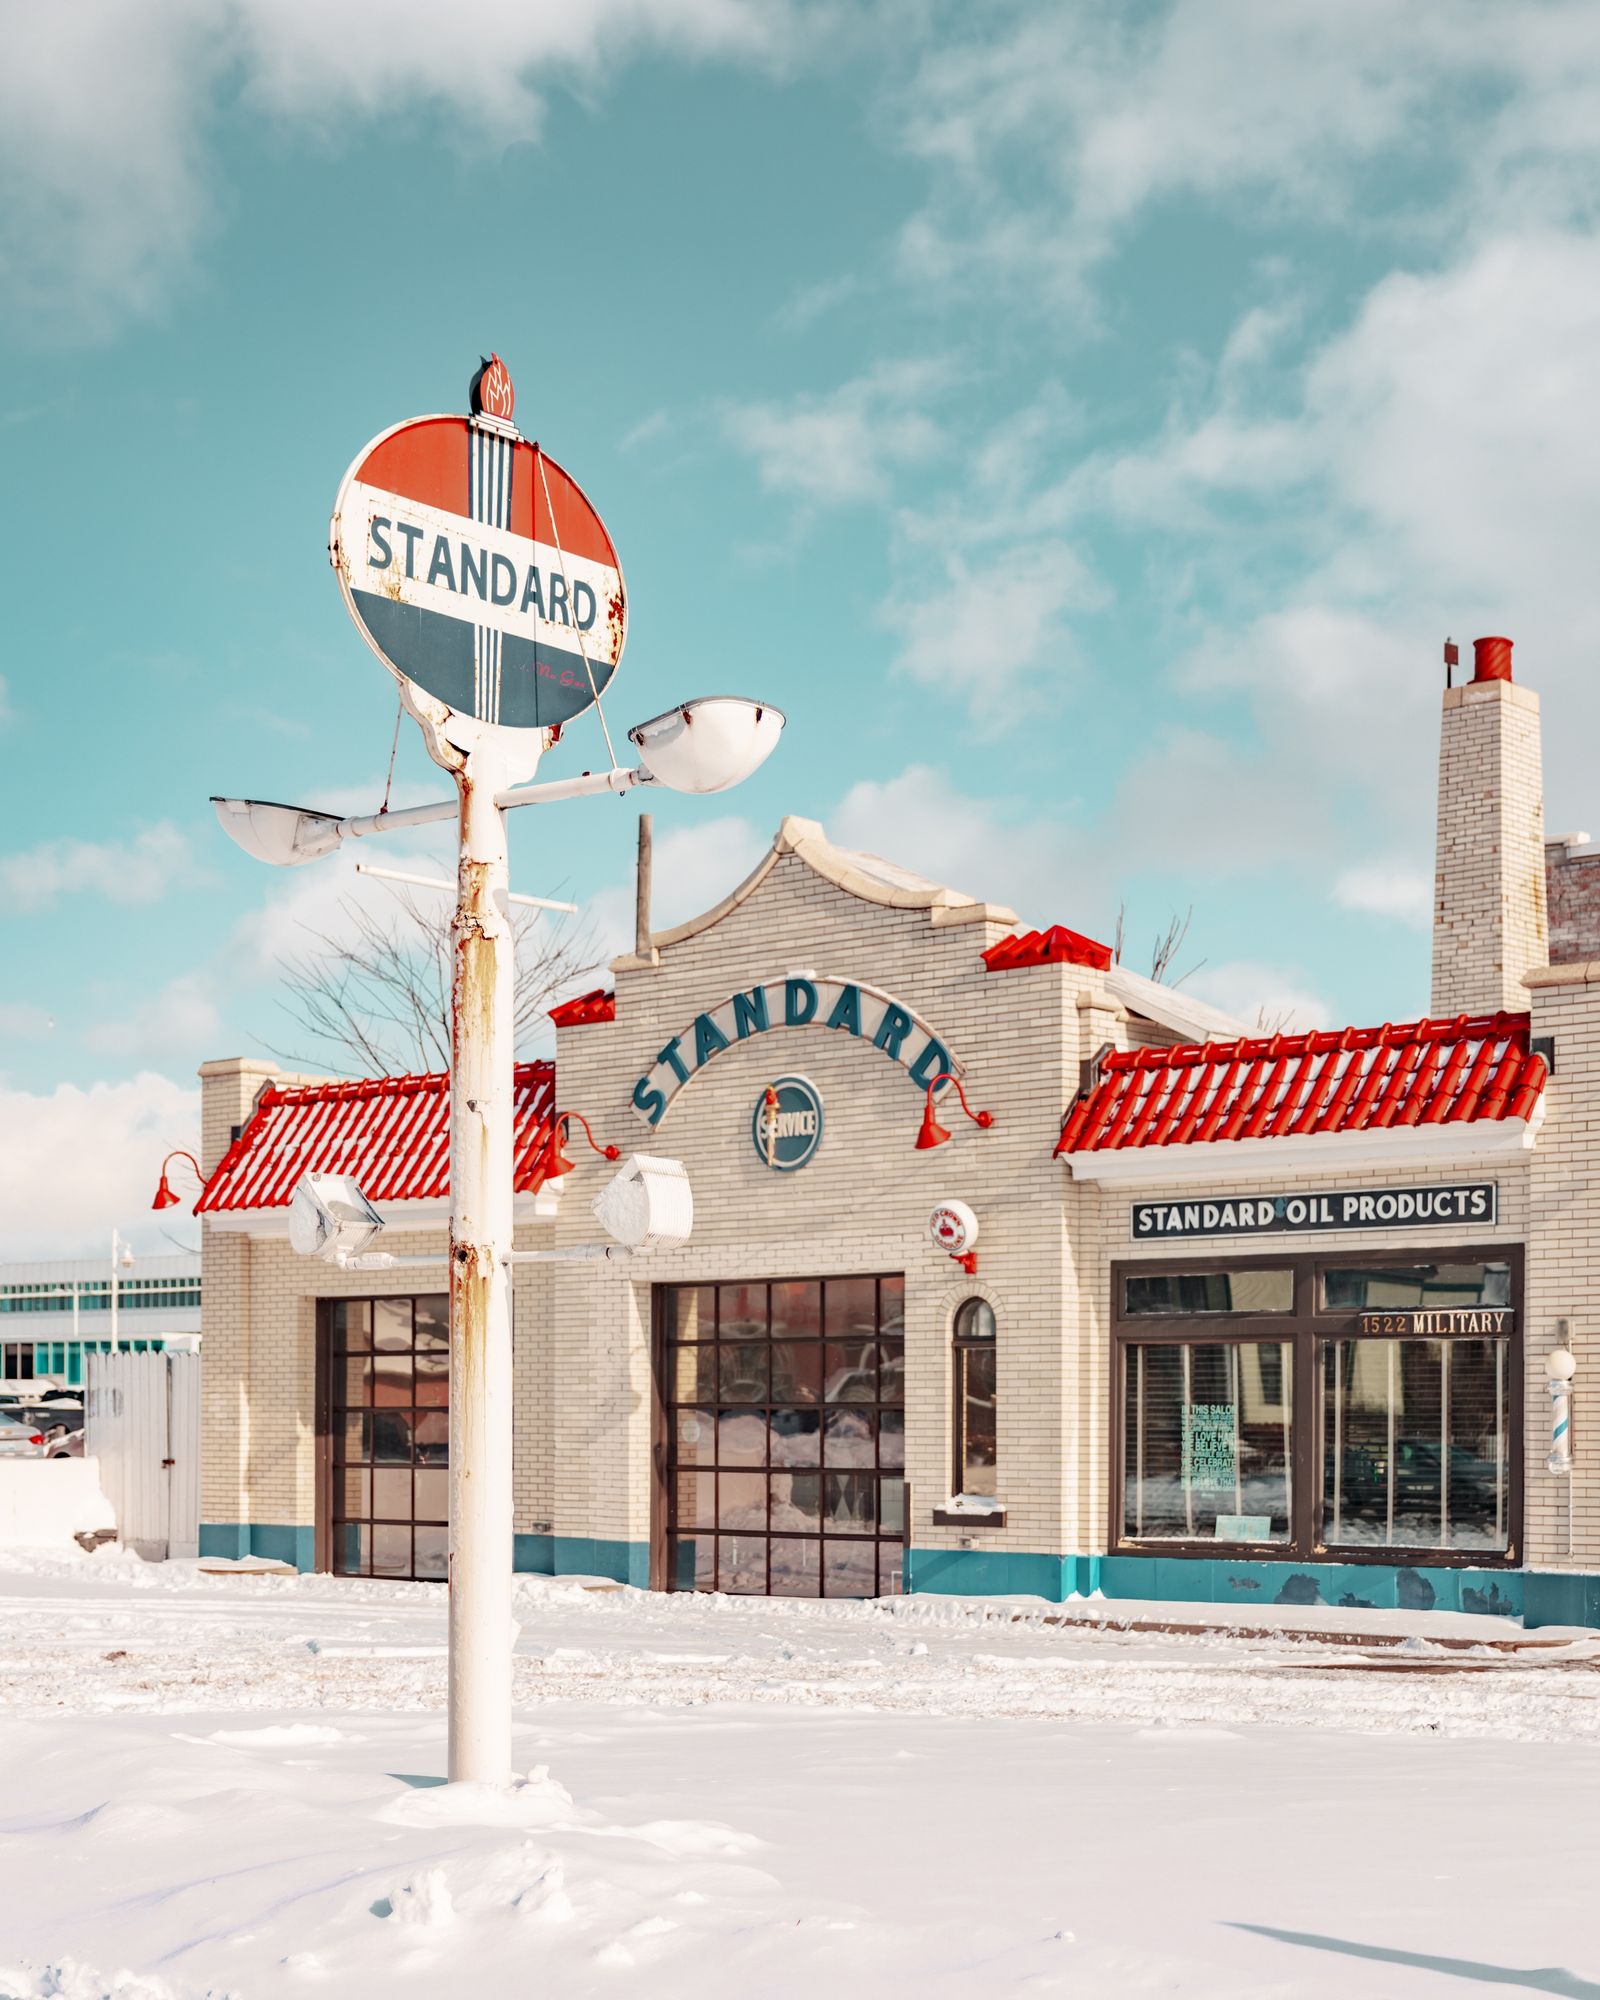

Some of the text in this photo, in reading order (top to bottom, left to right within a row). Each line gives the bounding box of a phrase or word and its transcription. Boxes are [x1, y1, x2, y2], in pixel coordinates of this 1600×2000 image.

[368, 516, 597, 631] STANDARD
[633, 978, 952, 1125] STANDARD
[1138, 1189, 1487, 1232] STANDARD OIL PRODUCTS
[1362, 1312, 1505, 1334] 1522 MILITARY
[1191, 1404, 1209, 1414] THIS
[1195, 1432, 1216, 1441] LOVE
[1195, 1441, 1227, 1451] BELIEVE
[1193, 1458, 1237, 1467] CELEBRATE
